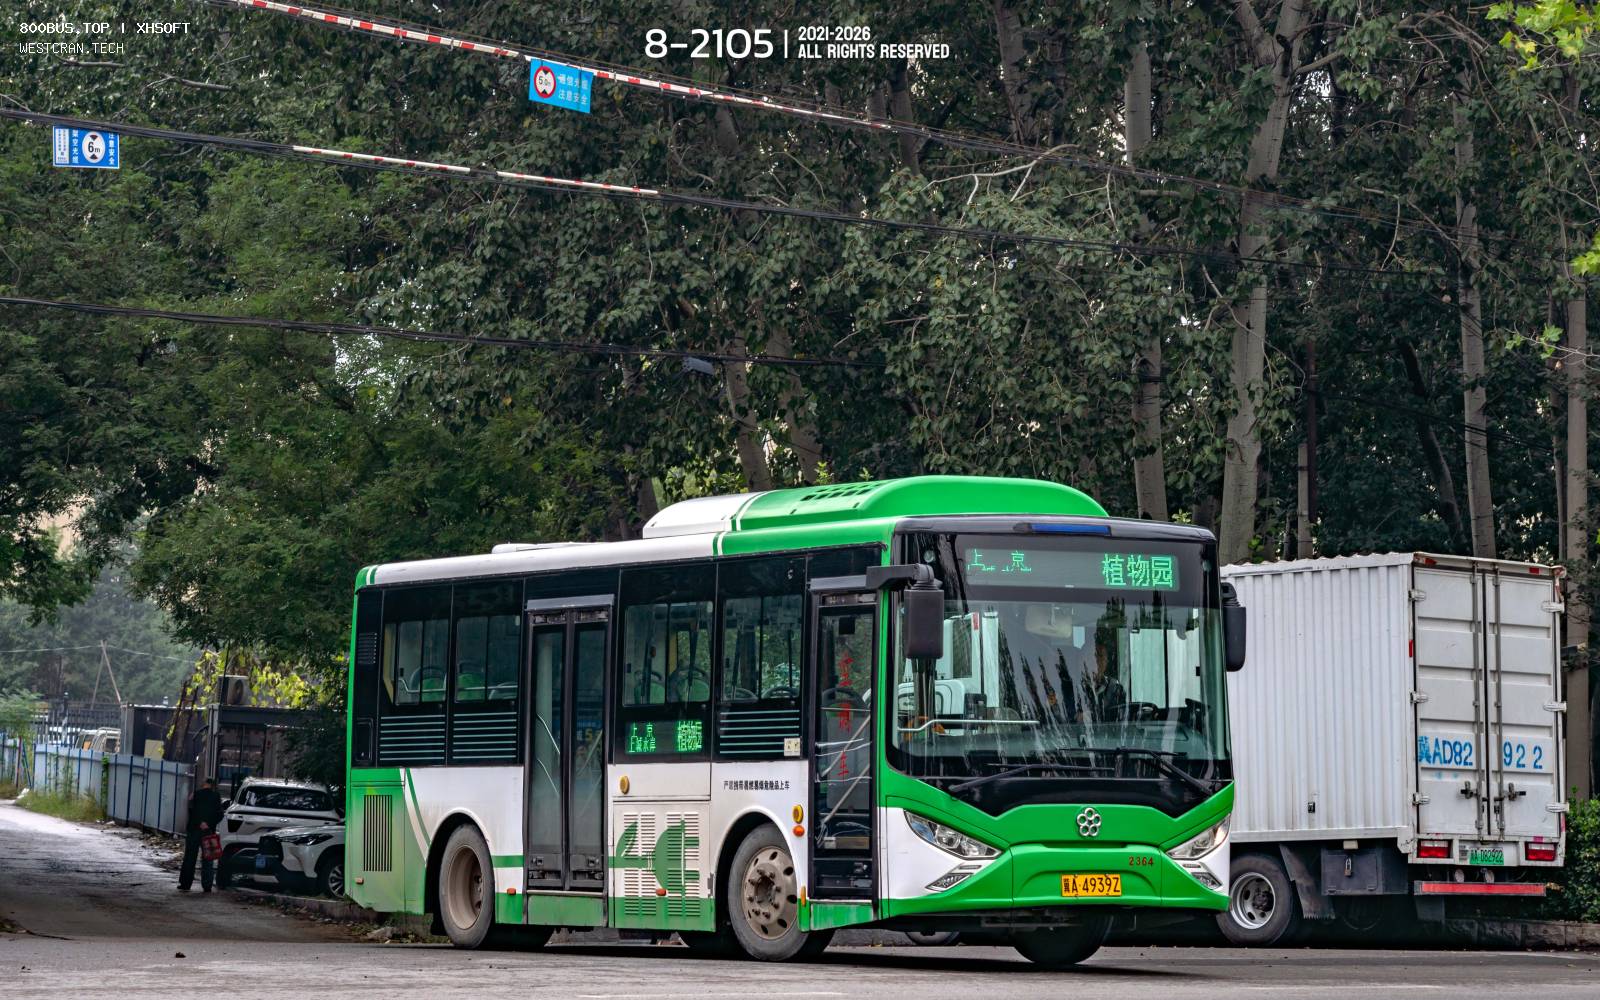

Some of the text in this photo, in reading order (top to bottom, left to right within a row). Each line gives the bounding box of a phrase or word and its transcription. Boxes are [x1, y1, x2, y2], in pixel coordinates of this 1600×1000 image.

[87, 141, 101, 153] 6m
[1102, 553, 1174, 588] 植物园
[1128, 856, 1155, 867] 2364
